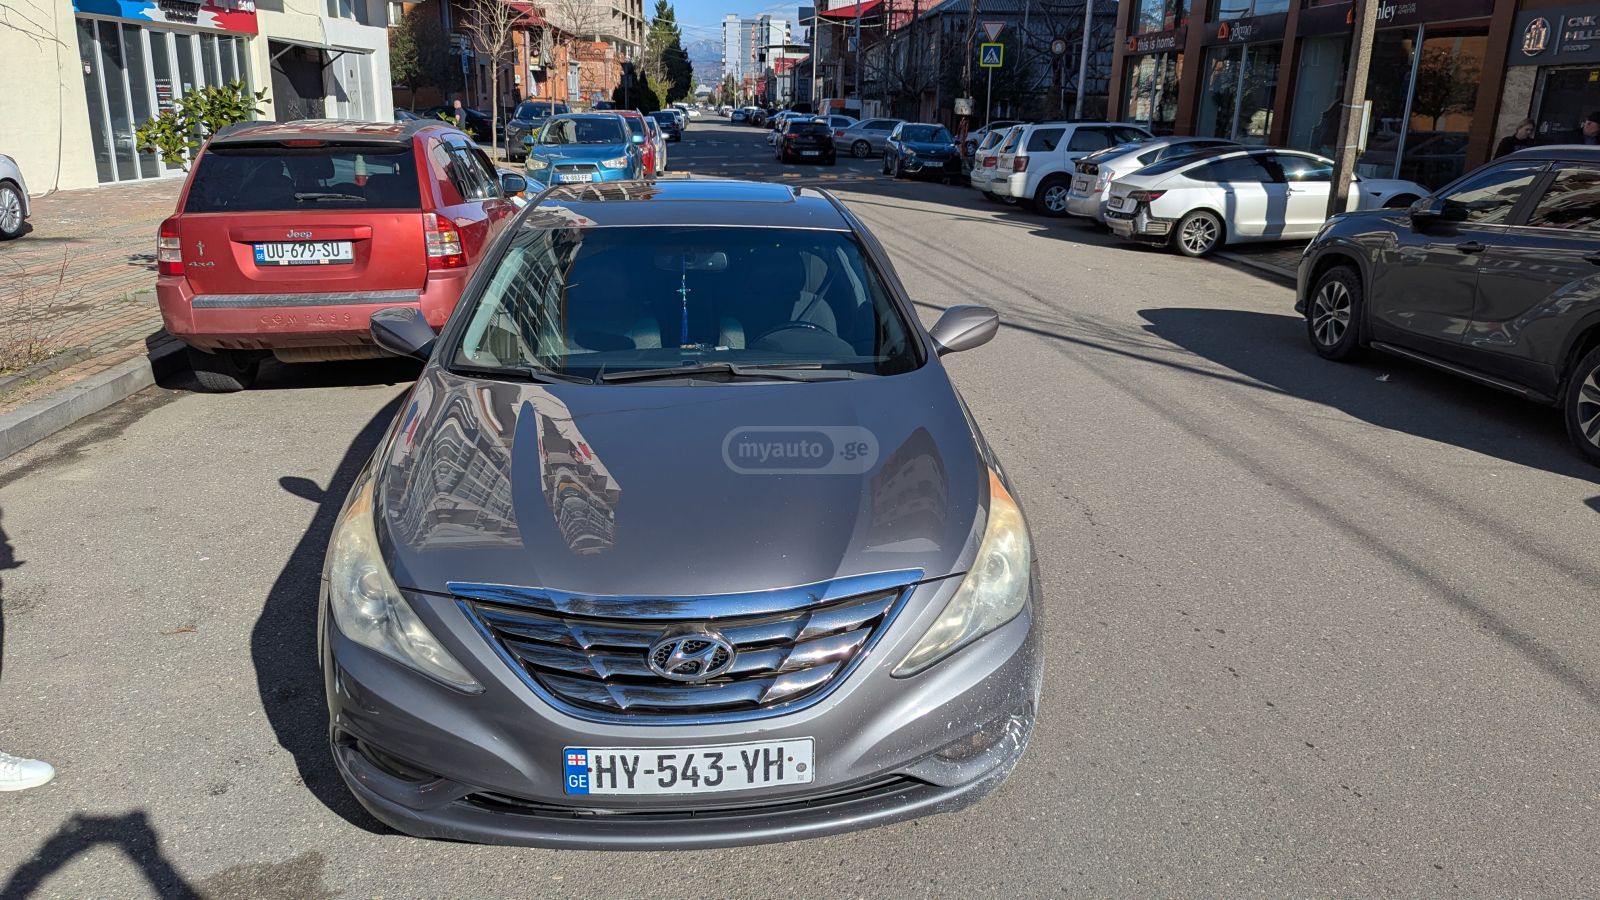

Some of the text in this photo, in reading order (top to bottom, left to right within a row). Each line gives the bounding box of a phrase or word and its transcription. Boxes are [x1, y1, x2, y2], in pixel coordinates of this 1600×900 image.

[1568, 16, 1597, 27] CNK
[1137, 37, 1149, 51] this
[1149, 36, 1156, 50] is
[286, 229, 313, 239] Jeep
[266, 242, 341, 259] UU-679-SU
[260, 312, 351, 325] COMPASS
[595, 747, 784, 789] HY-543-YH
[569, 774, 587, 788] GE
